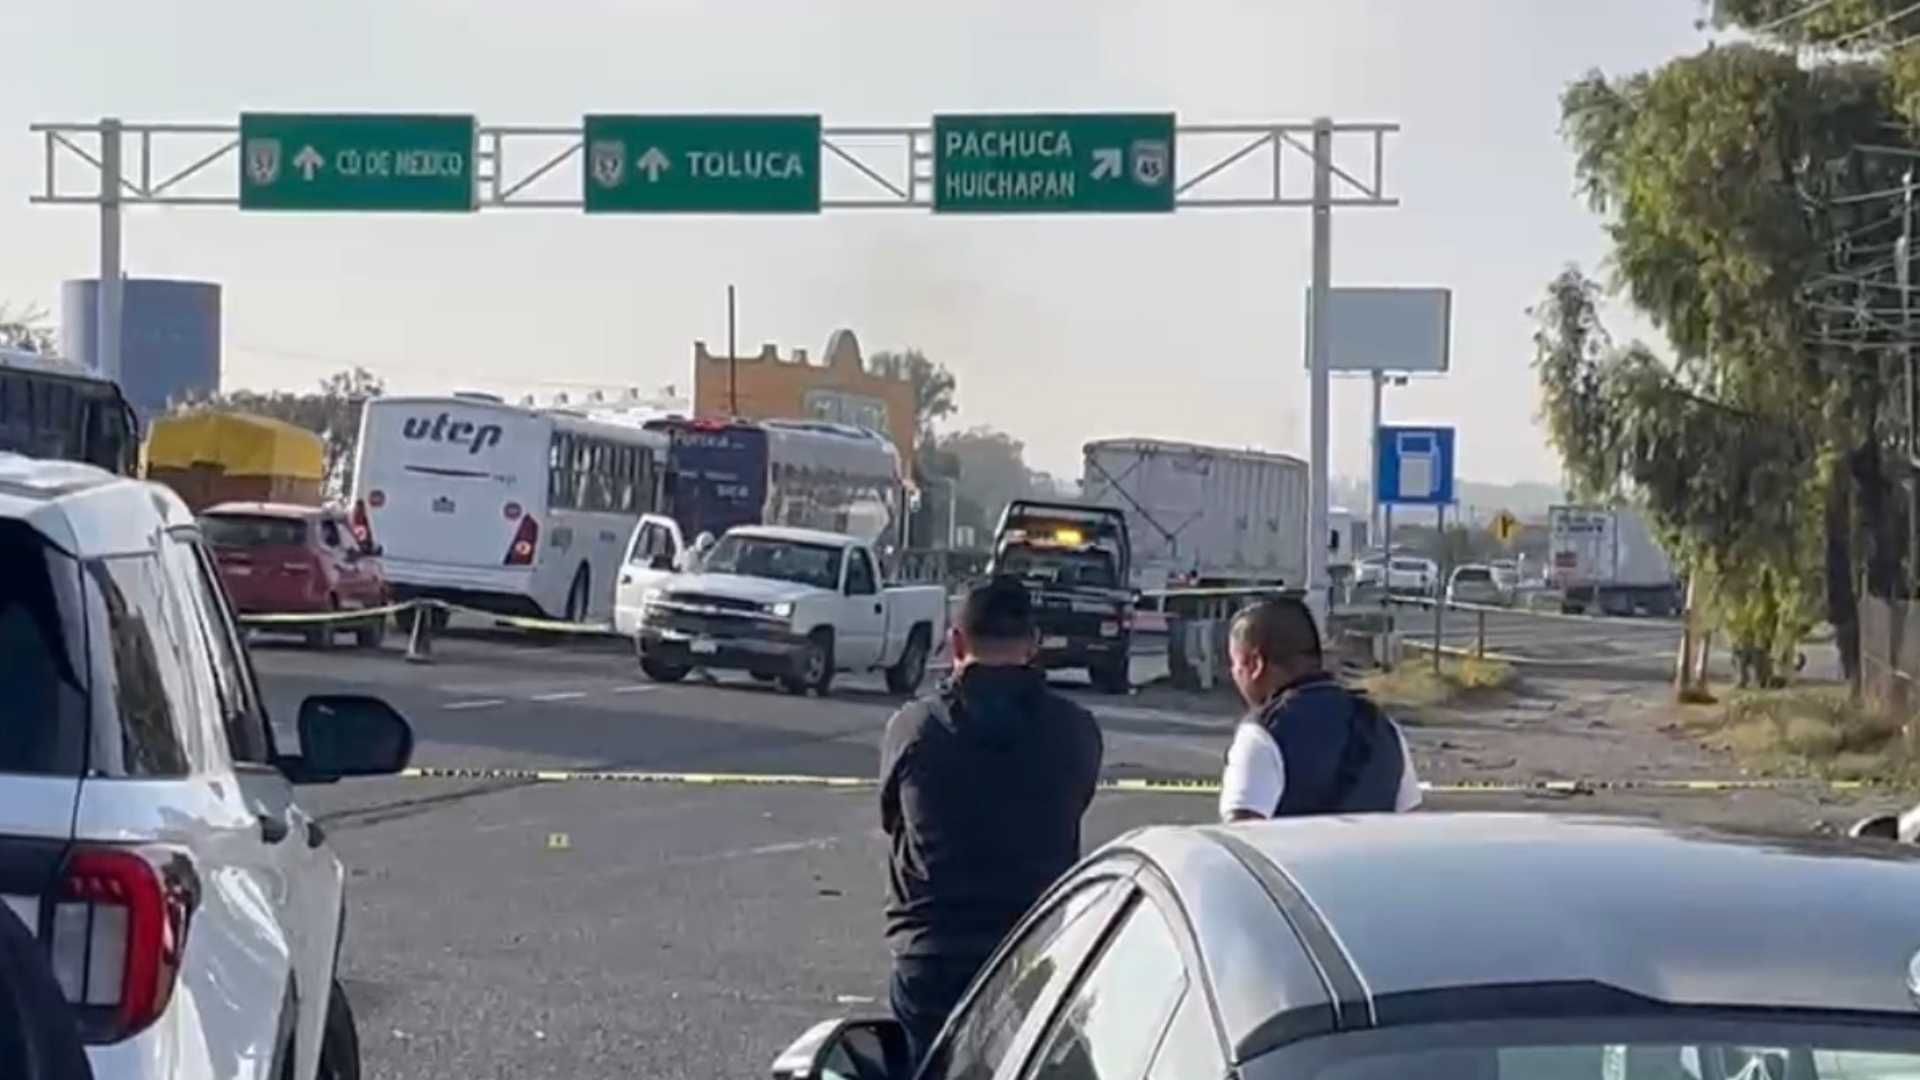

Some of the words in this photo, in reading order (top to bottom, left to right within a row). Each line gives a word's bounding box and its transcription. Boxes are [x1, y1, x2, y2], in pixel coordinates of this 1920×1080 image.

[945, 131, 1073, 157] PACHUCA
[365, 151, 391, 176] DE
[685, 151, 804, 178] TOLUCA
[945, 172, 1075, 198] HUICHAPAN
